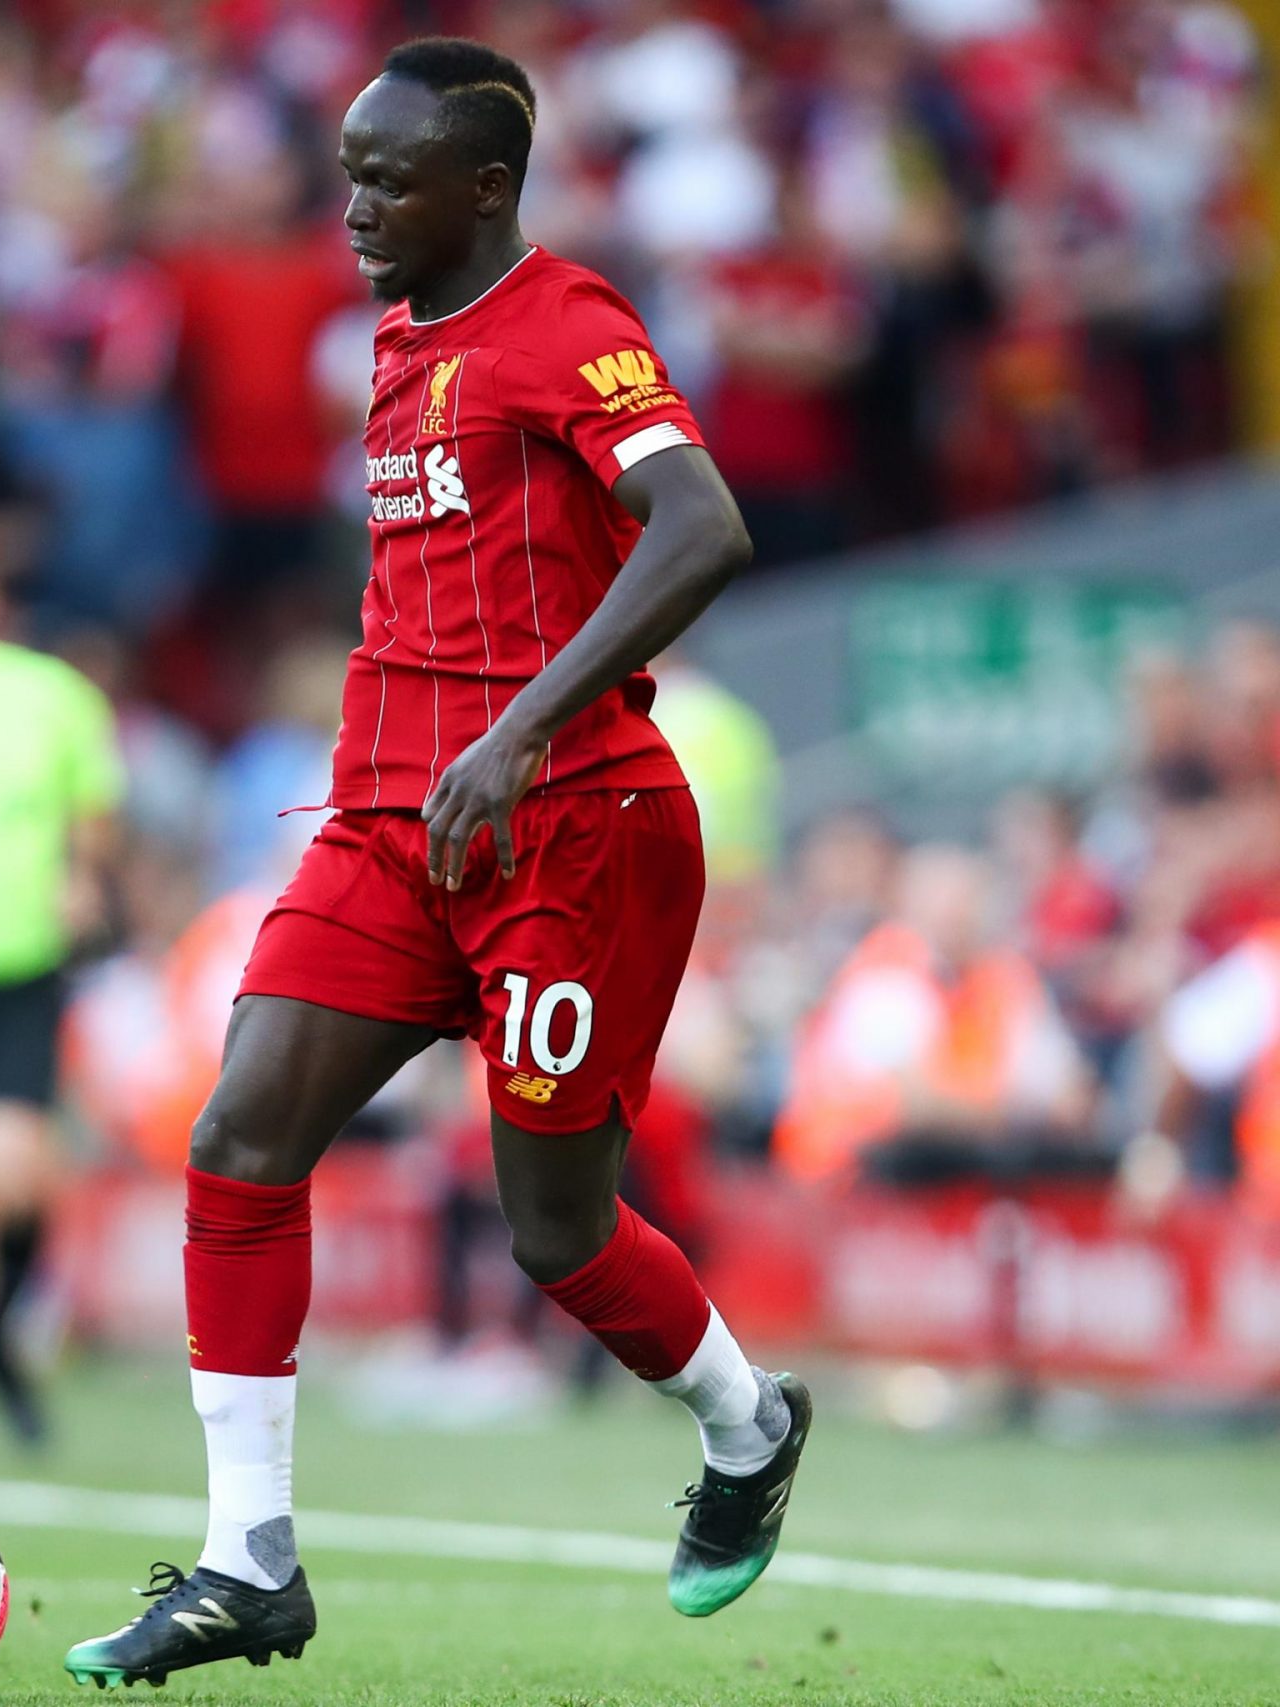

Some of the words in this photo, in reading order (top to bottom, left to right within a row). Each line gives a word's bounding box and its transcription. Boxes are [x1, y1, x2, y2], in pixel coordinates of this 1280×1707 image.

[600, 384, 663, 413] Weste
[628, 393, 680, 413] Union
[365, 446, 419, 483] andard
[372, 486, 425, 520] artered
[502, 972, 594, 1075] 10
